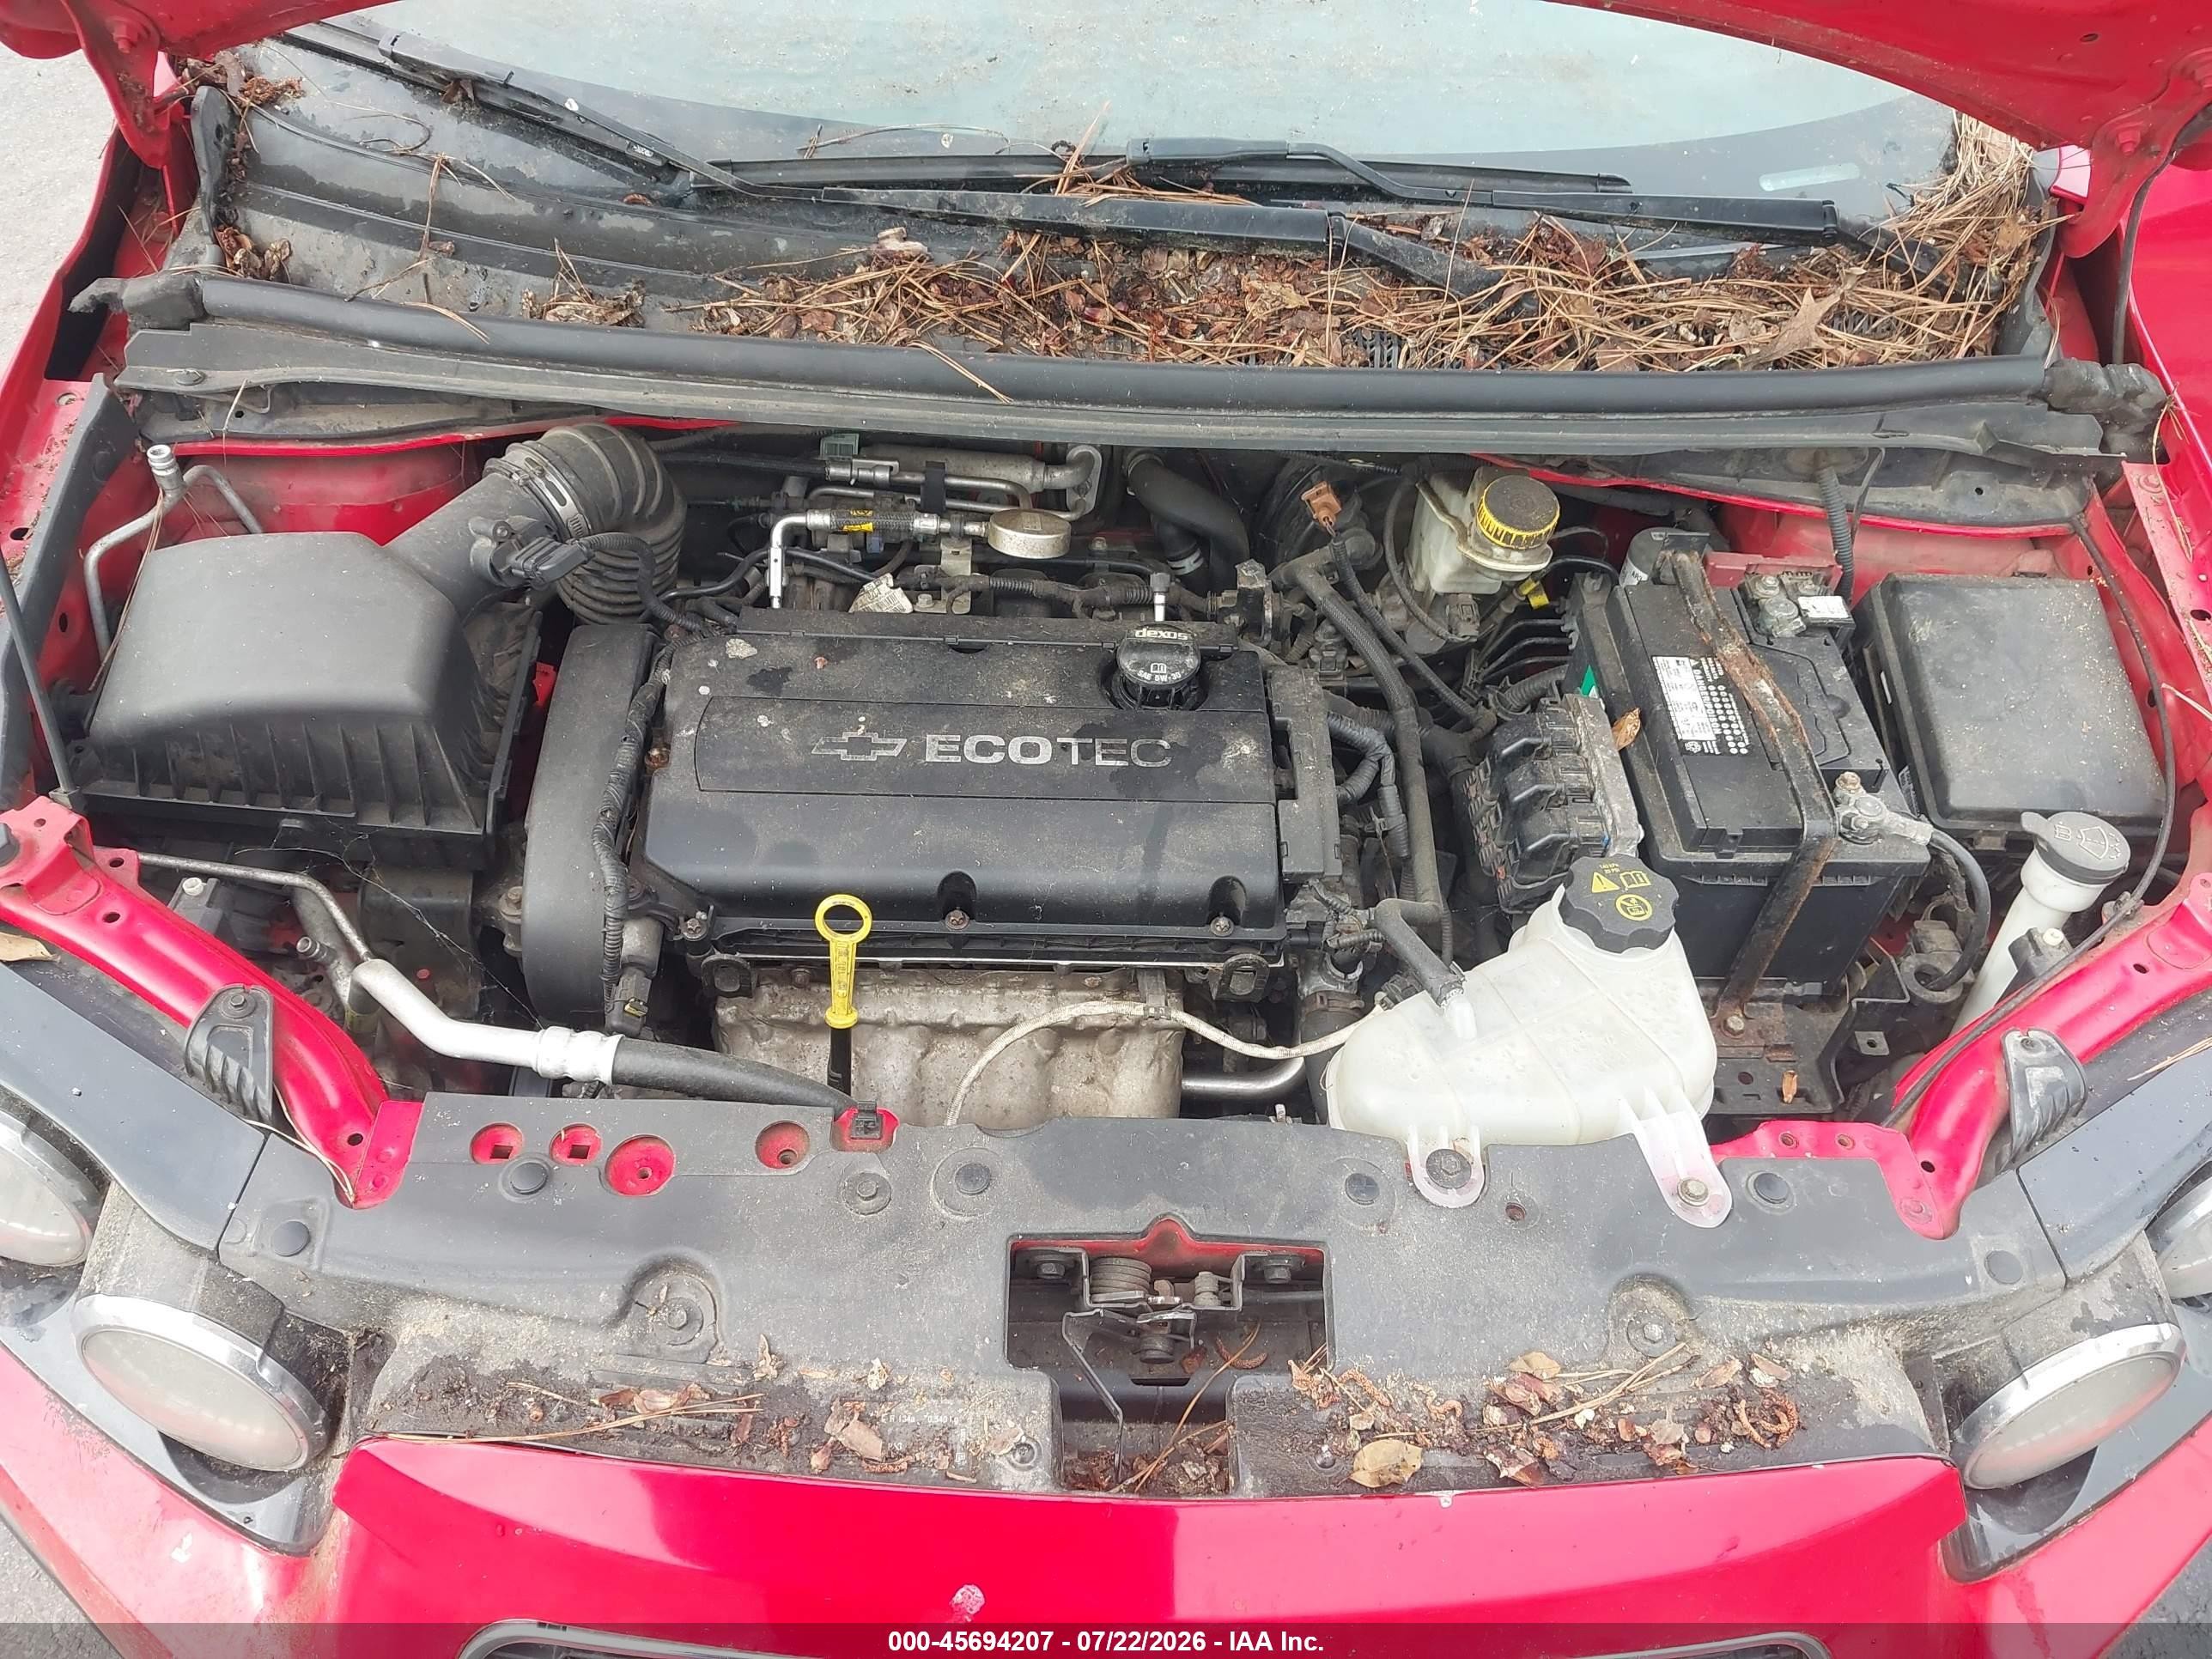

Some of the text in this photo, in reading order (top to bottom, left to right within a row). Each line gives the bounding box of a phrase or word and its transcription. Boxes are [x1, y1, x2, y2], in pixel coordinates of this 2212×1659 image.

[1134, 628, 1189, 641] dexos
[1137, 670, 1182, 682] SAE 5W-30
[1692, 669, 1723, 735] DANGER/POISON
[925, 734, 1172, 767] ECOTEC
